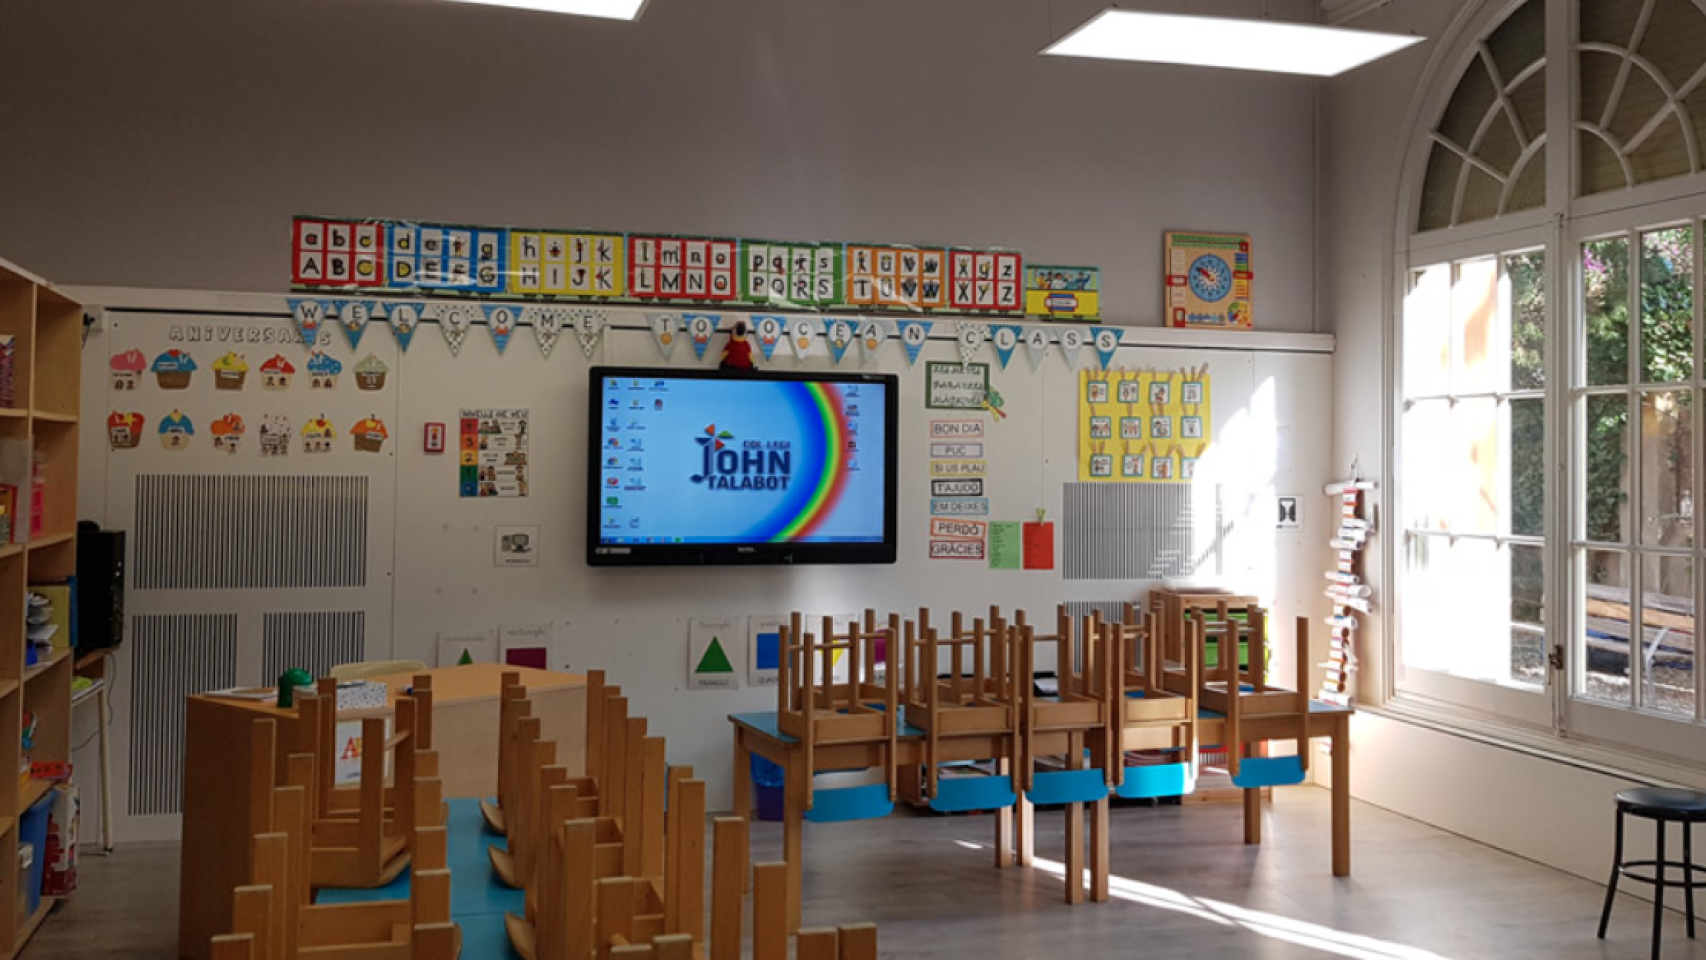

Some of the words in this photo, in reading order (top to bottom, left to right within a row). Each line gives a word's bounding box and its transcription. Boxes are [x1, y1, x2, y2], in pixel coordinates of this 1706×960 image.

[168, 325, 332, 346] ANIVERSARS
[301, 304, 591, 329] WELCOME
[661, 317, 708, 335] TO
[763, 318, 919, 341] OCEAN
[966, 331, 1111, 349] CLASS
[935, 423, 959, 435] BON
[962, 423, 980, 434] DIA
[691, 437, 791, 482] JOHN
[708, 475, 791, 491] TALABOT
